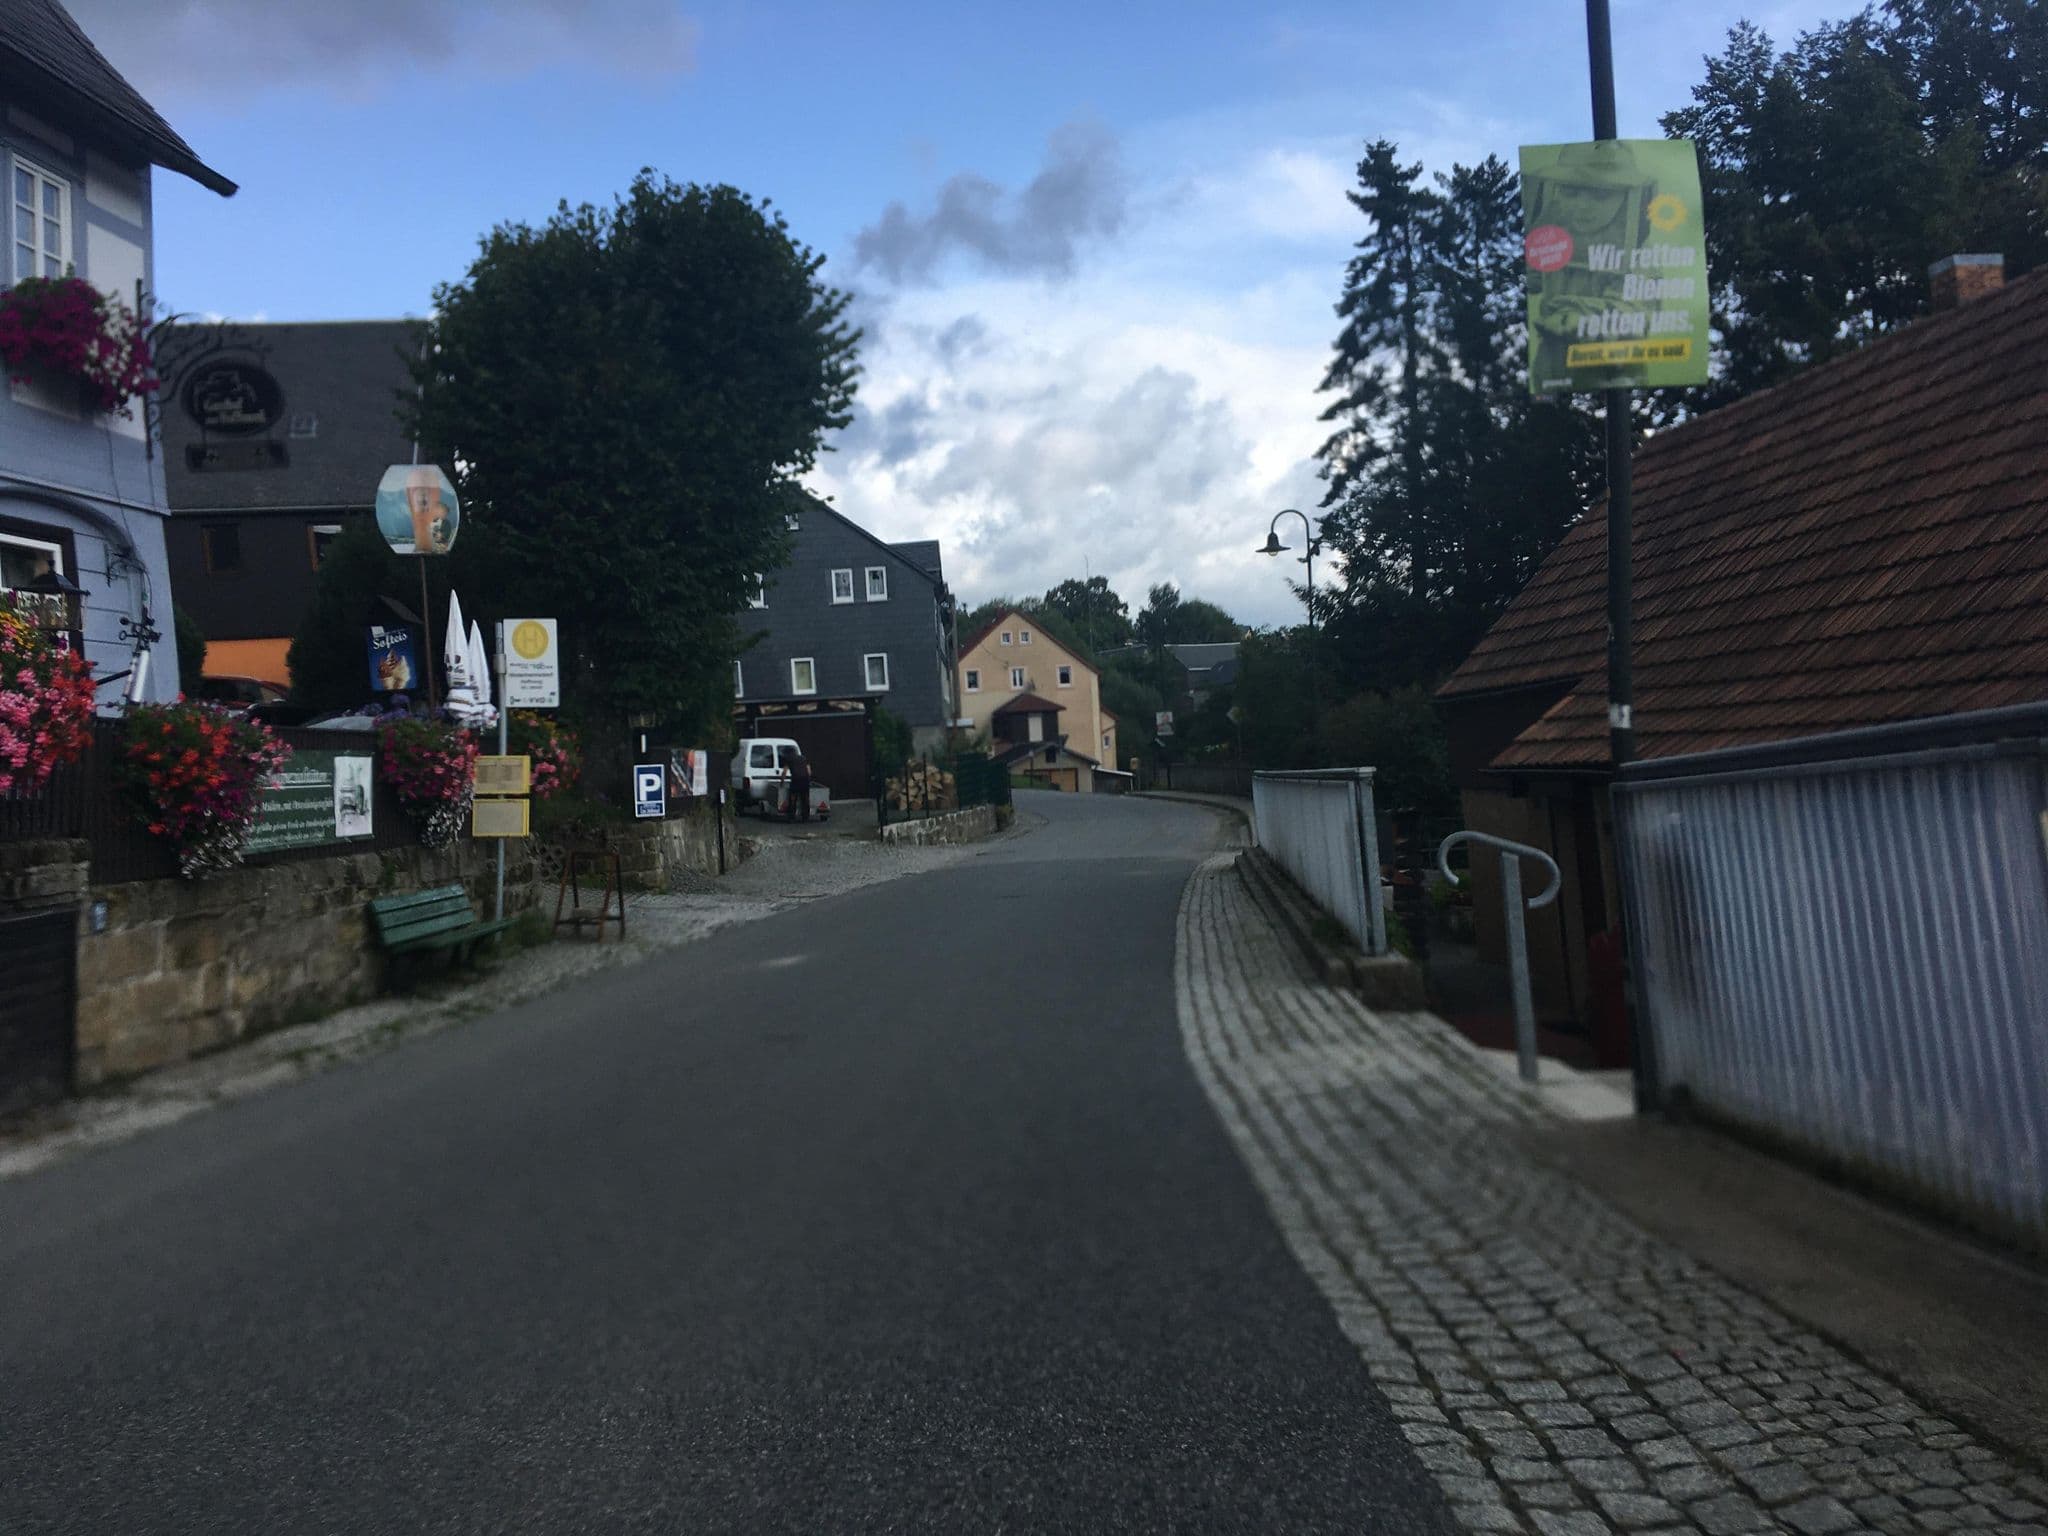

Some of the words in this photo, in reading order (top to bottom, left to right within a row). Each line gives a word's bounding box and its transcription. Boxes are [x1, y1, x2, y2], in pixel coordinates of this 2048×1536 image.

[1588, 244, 1625, 272] Wir
[1630, 243, 1696, 269] retten
[1622, 273, 1696, 301] Bienen
[1577, 308, 1646, 338] retten
[1650, 310, 1696, 334] uns.
[373, 632, 407, 649] Softeis
[639, 774, 661, 801] P
